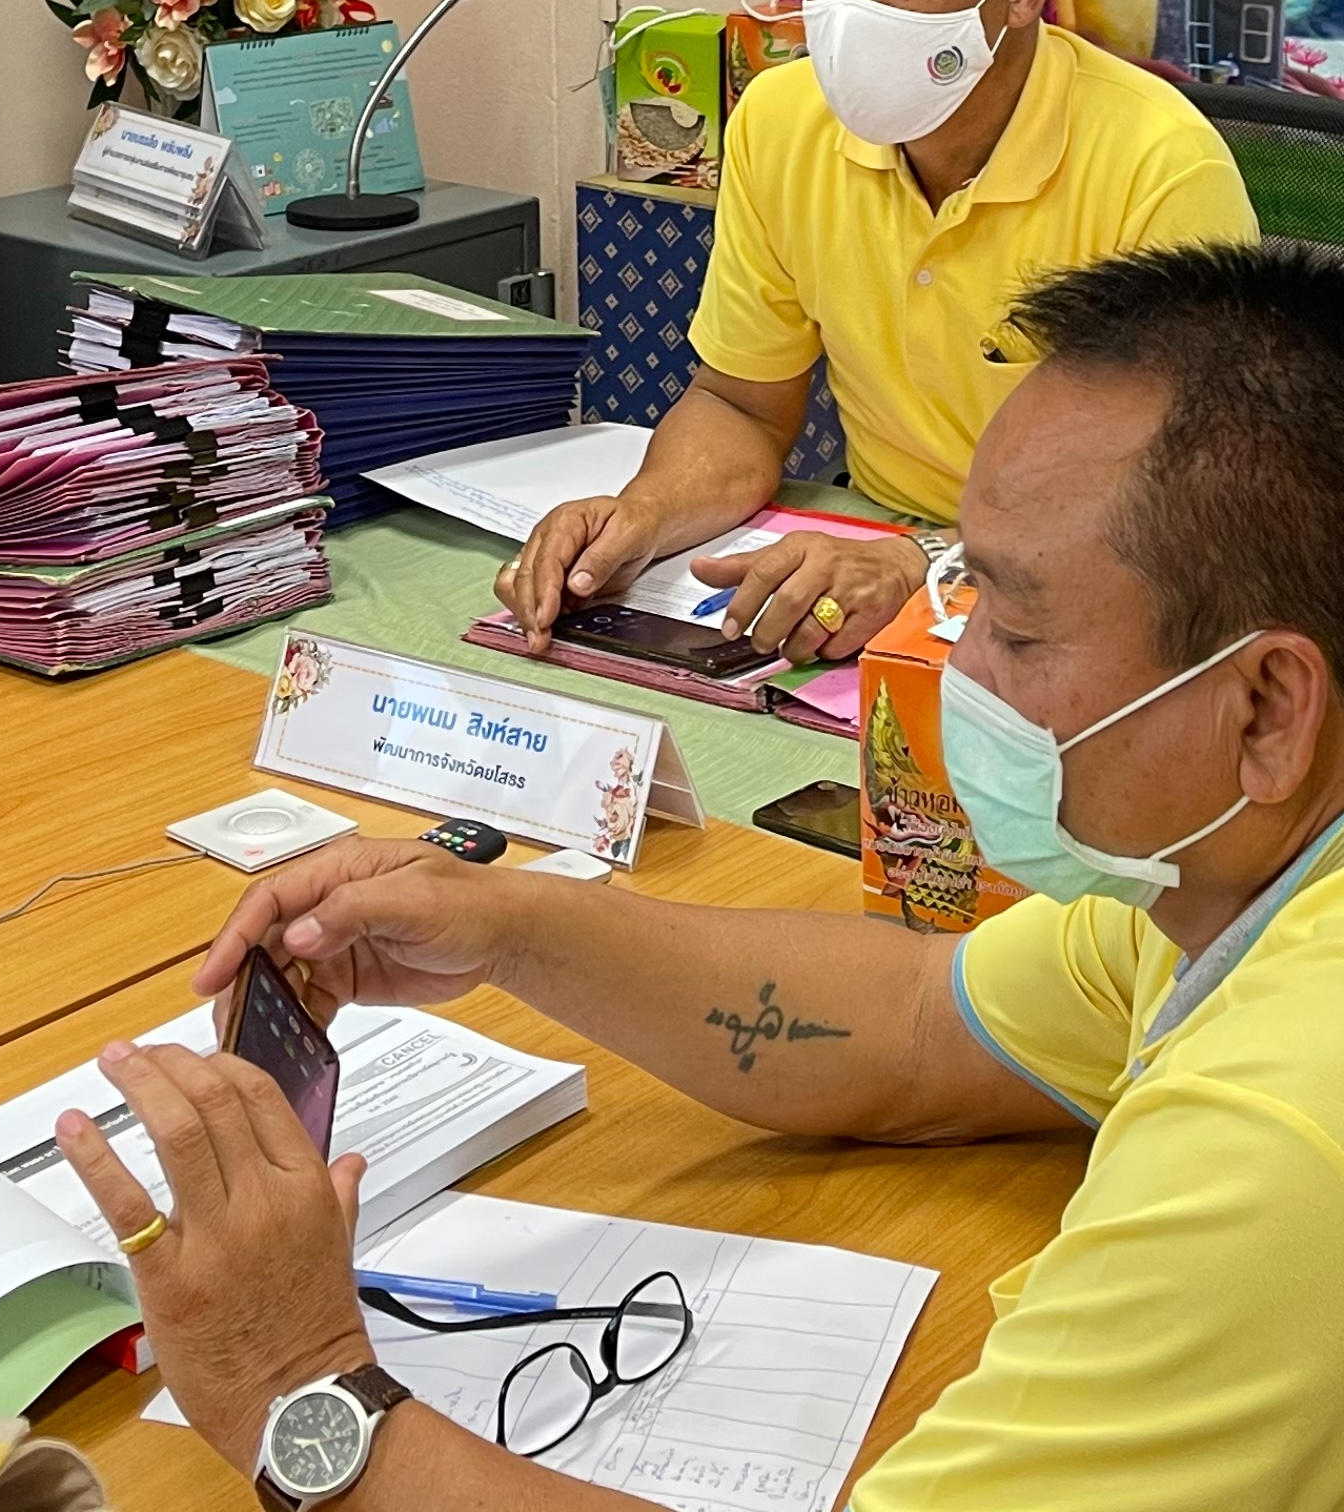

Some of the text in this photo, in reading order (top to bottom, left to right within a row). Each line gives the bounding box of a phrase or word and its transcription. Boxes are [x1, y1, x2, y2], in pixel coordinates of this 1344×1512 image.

[372, 694, 548, 753] นายพนม สิงห์สาย
[373, 736, 526, 789] พัฒนาการจังหวัดยโสธร
